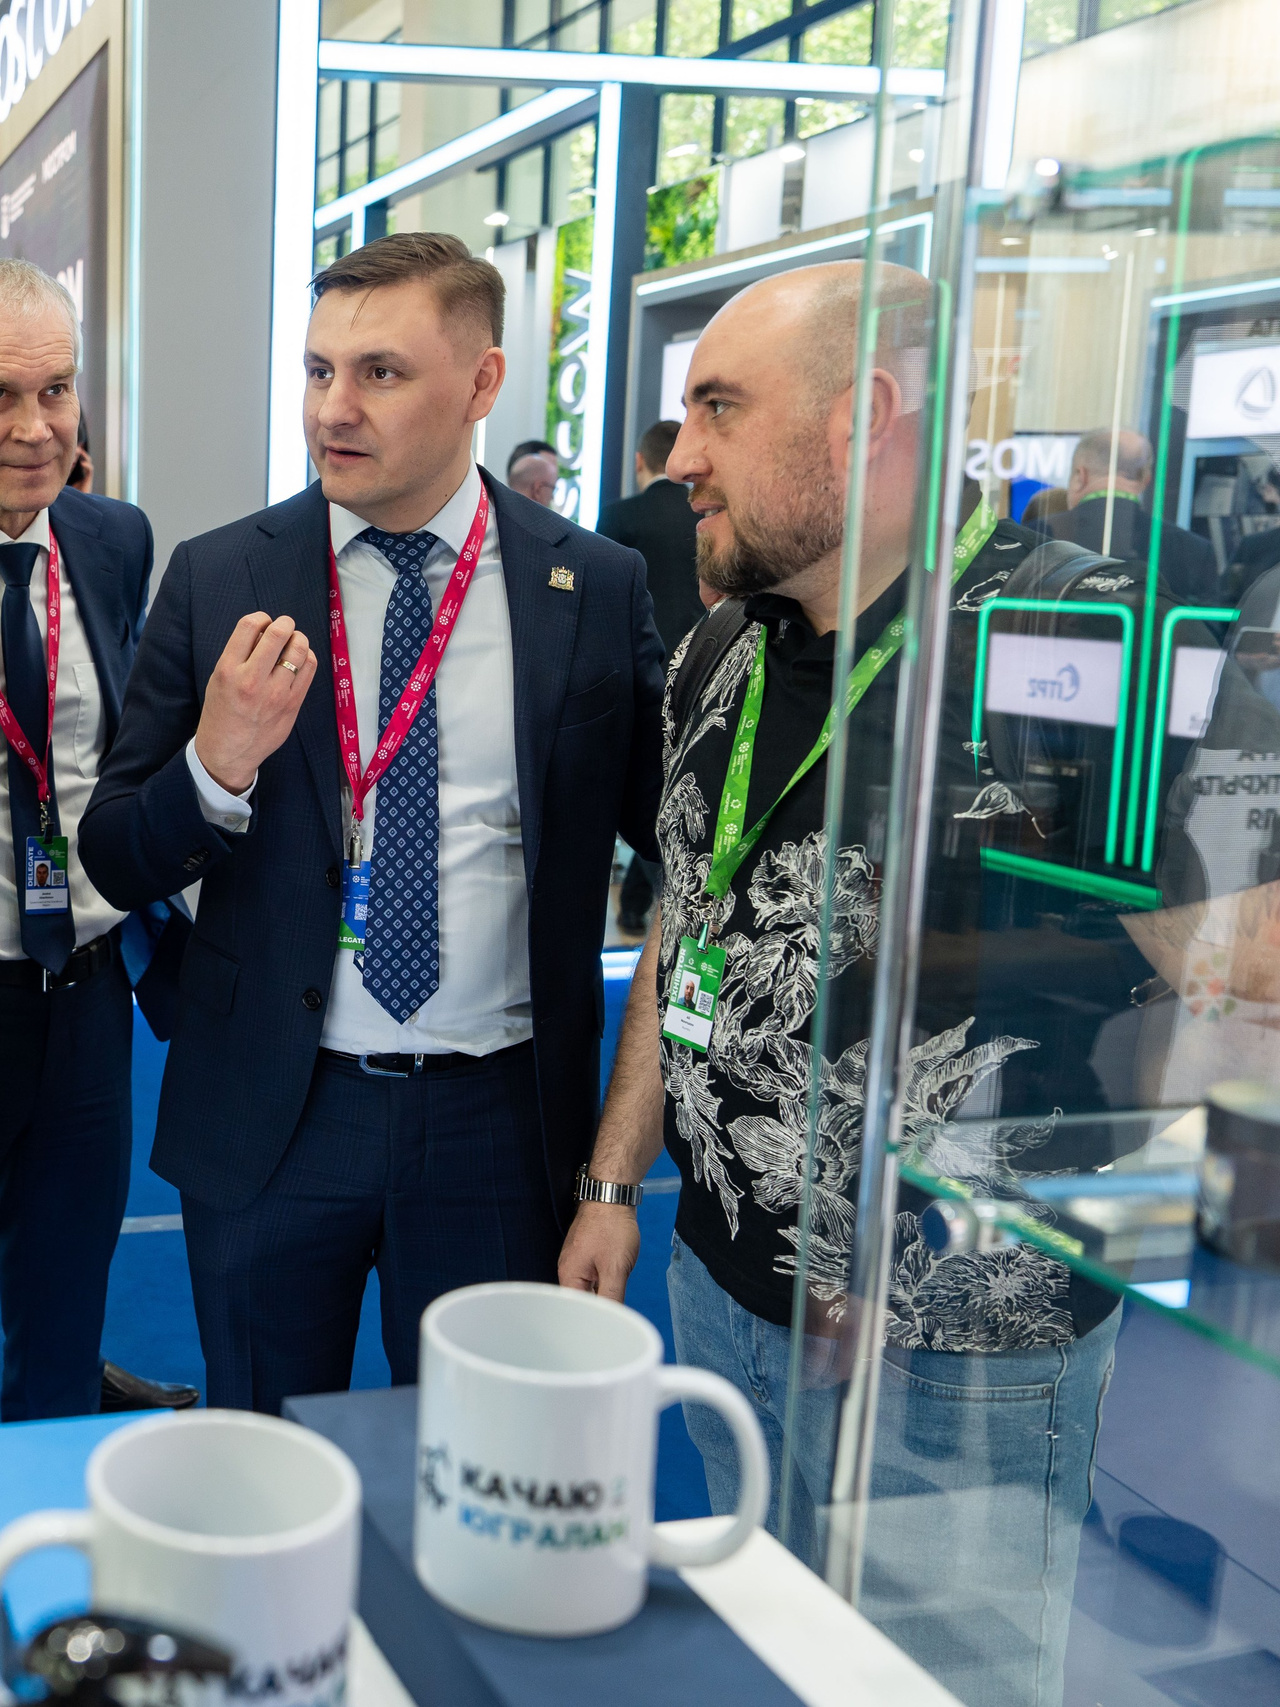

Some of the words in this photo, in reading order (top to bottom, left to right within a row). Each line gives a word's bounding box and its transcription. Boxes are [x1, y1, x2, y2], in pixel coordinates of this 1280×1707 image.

[27, 846, 35, 887] DELEGATE
[670, 948, 687, 1003] EXHIBITOR
[460, 1462, 605, 1513] КАЧАЮ
